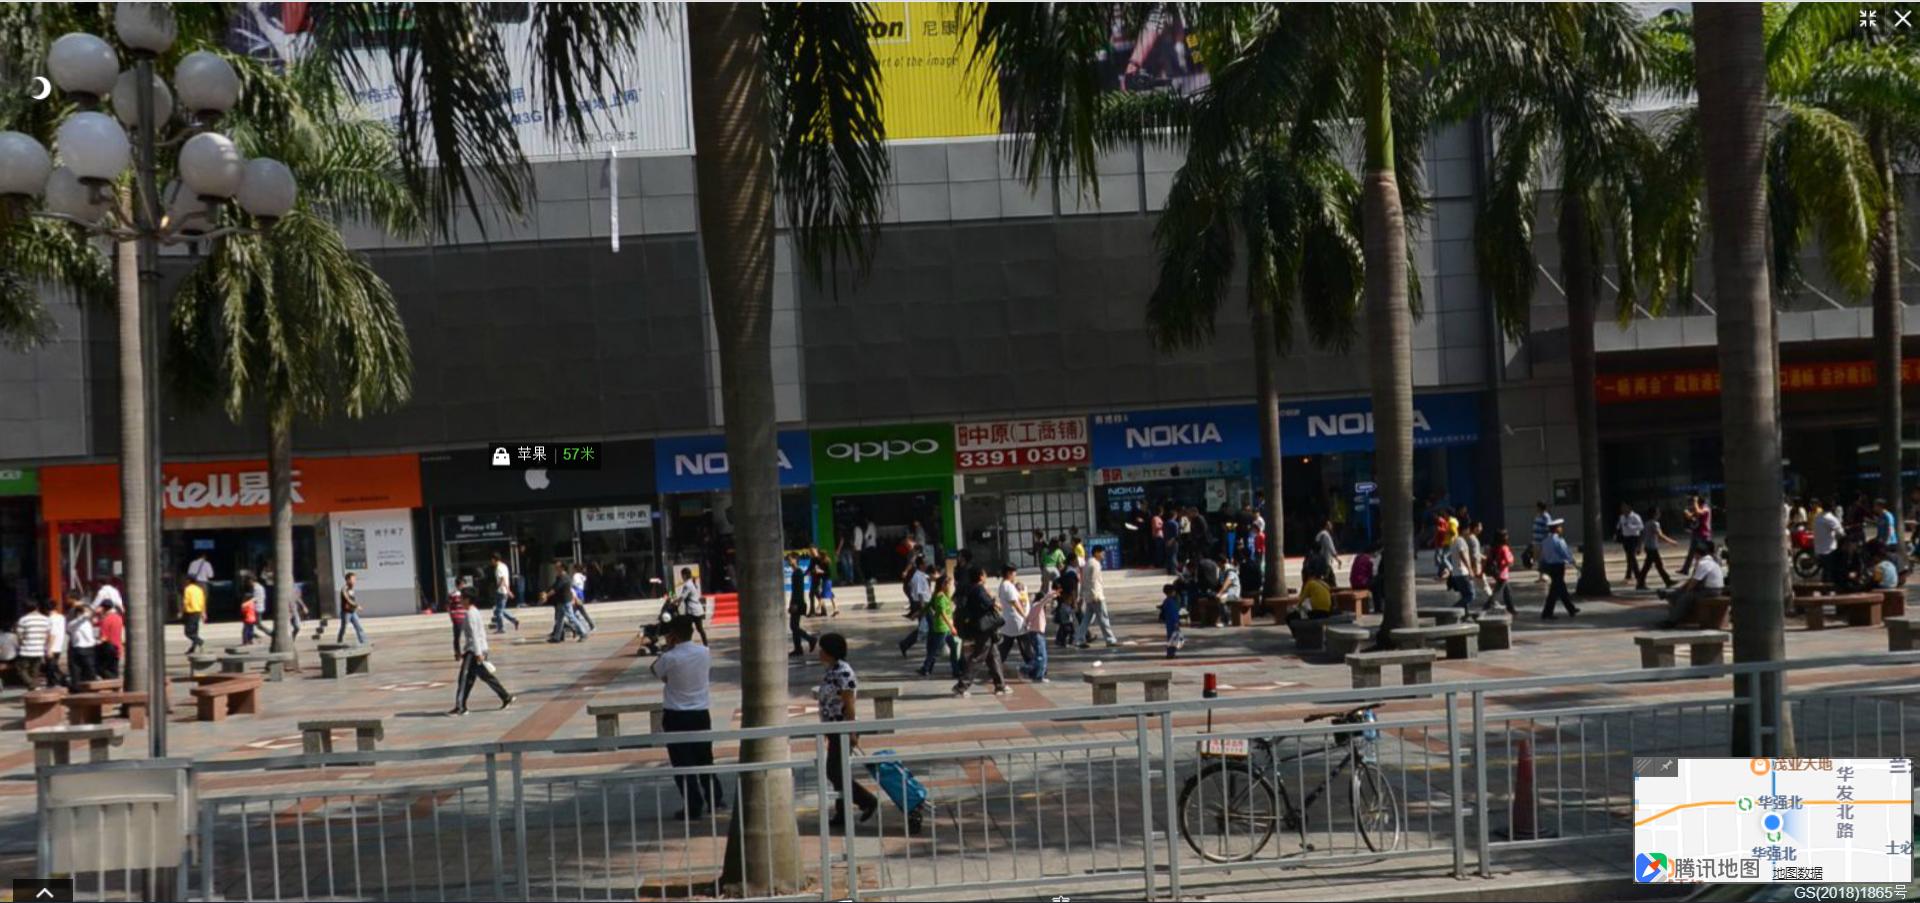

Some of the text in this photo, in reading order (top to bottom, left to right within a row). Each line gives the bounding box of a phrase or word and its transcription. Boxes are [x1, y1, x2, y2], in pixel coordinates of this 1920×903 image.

[1126, 422, 1222, 449] NOKIA
[1307, 409, 1431, 437] NOA
[675, 451, 793, 476] NOA
[959, 446, 1086, 467] 3391 0309
[1107, 486, 1145, 496] NOKIA
